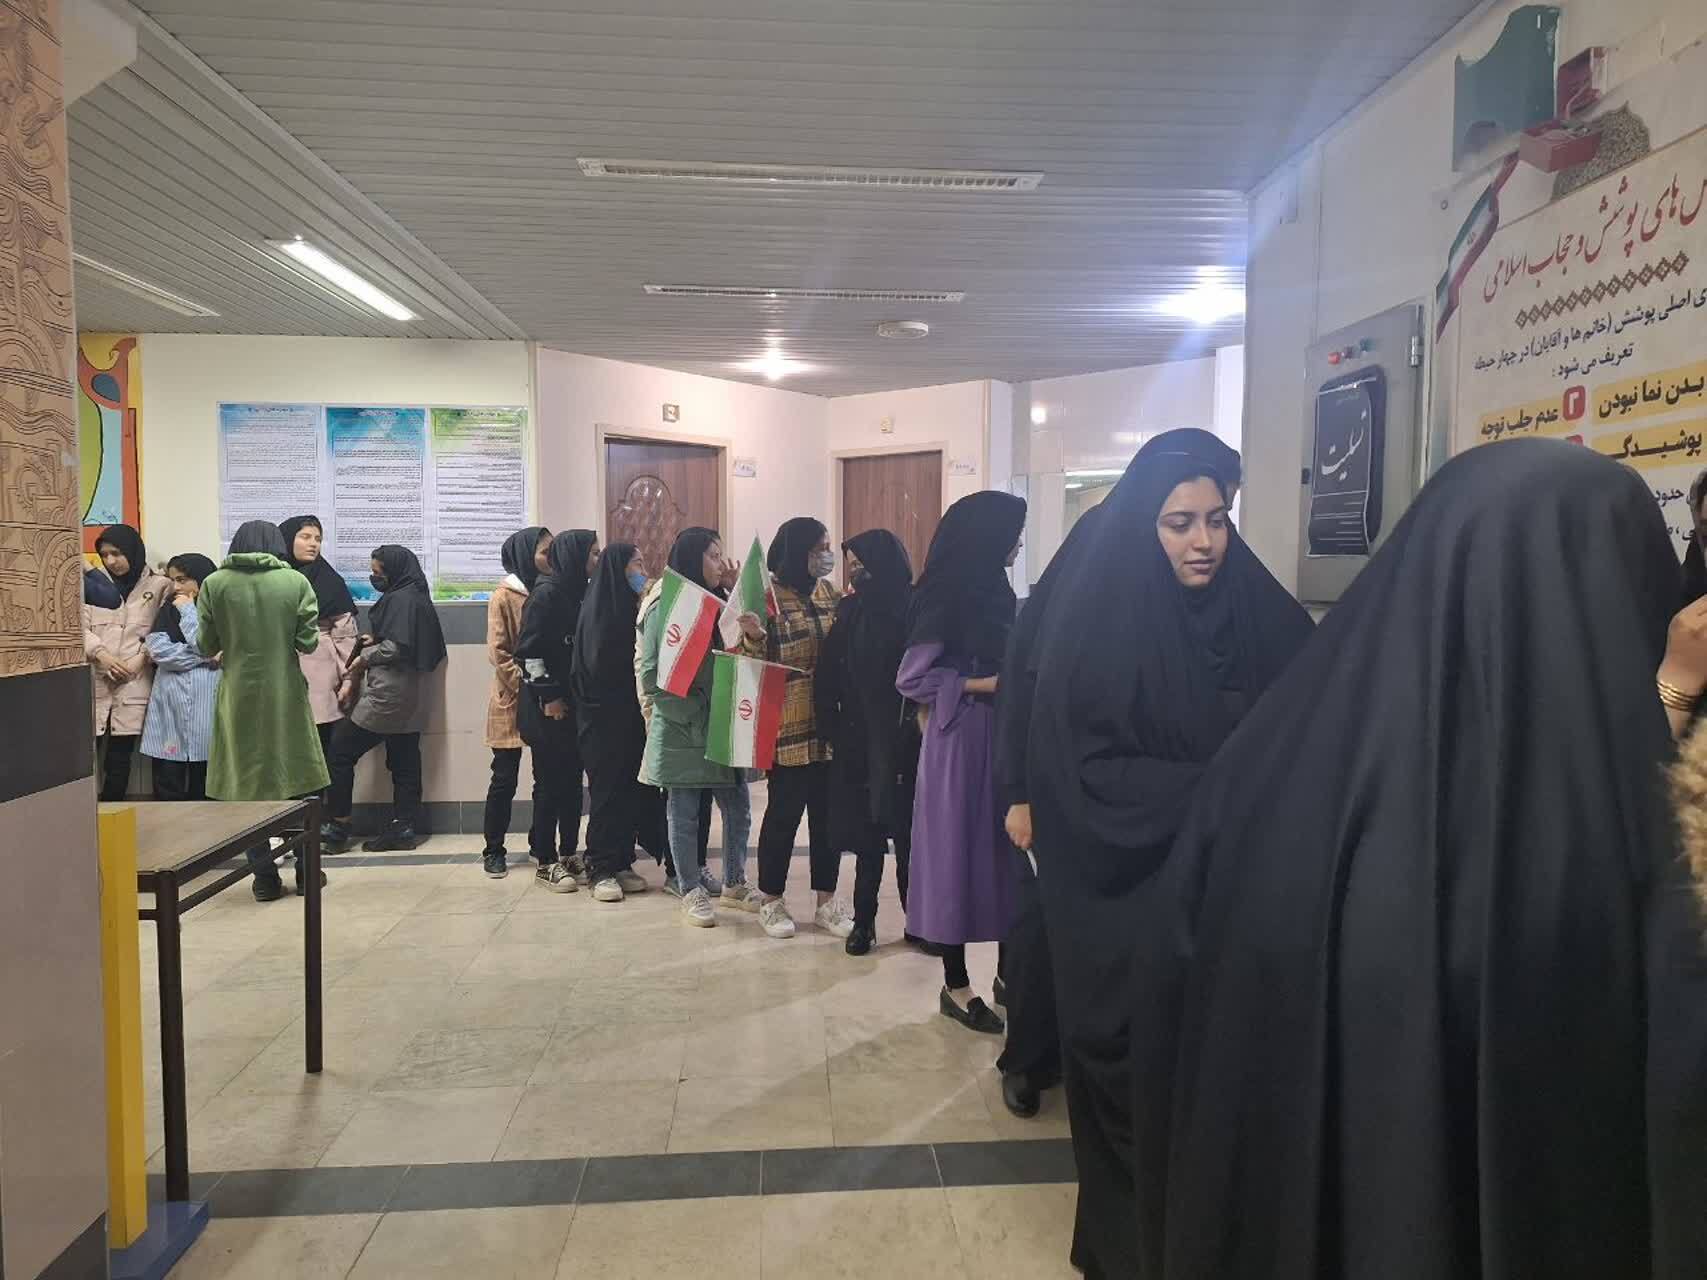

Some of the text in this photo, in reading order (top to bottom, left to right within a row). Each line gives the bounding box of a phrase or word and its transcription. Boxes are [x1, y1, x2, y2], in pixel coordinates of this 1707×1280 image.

[1584, 175, 1639, 264] پوشش
[1641, 172, 1680, 242] های
[1527, 231, 1576, 289] حجاب
[1575, 233, 1585, 256] و
[1484, 251, 1529, 303] اسلامی
[1614, 305, 1656, 334] پوشش
[1659, 288, 1691, 321] اصلی
[1599, 342, 1634, 366] تعریف
[1599, 375, 1705, 418] بدن نما نبودن
[1321, 408, 1368, 481] تسلیت
[1606, 429, 1703, 459] پوشیدگ
